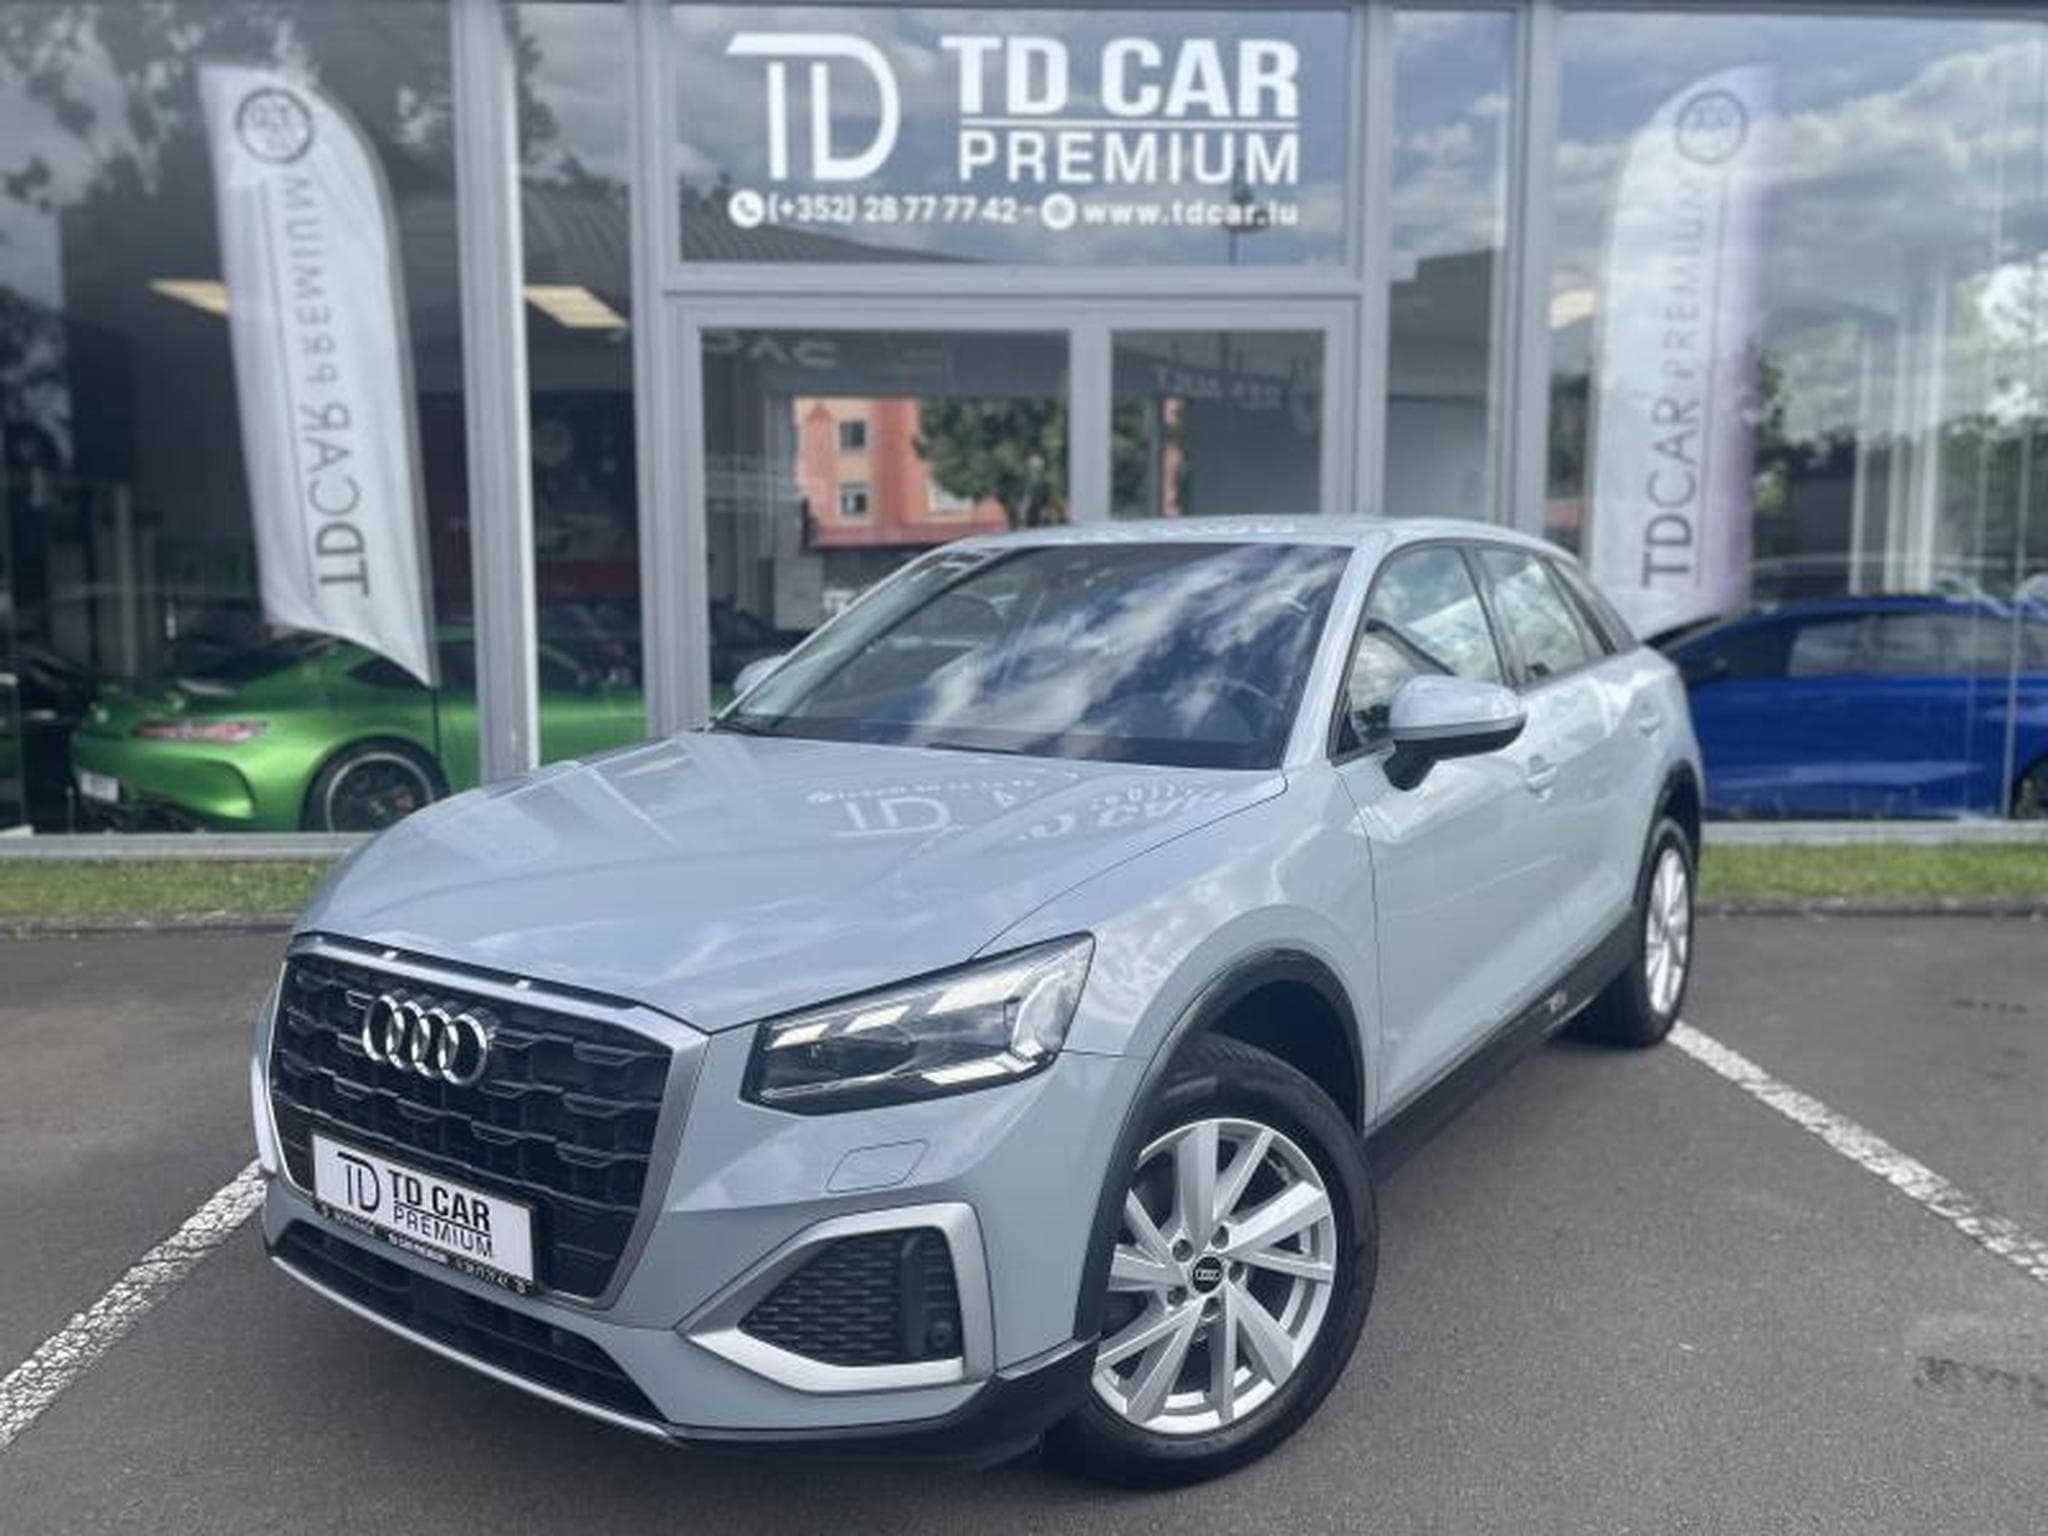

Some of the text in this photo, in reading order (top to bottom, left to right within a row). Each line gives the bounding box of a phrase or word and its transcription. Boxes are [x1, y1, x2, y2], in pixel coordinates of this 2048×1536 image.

[941, 36, 1300, 118] TD CAR
[959, 130, 1299, 185] PREMIUM
[768, 193, 856, 225] (+352)
[1082, 199, 1299, 227] www.tdcar.lu
[1641, 398, 1699, 588] TDCAR
[388, 1169, 491, 1232] TD CAR
[393, 1203, 493, 1259] PREMIUM
